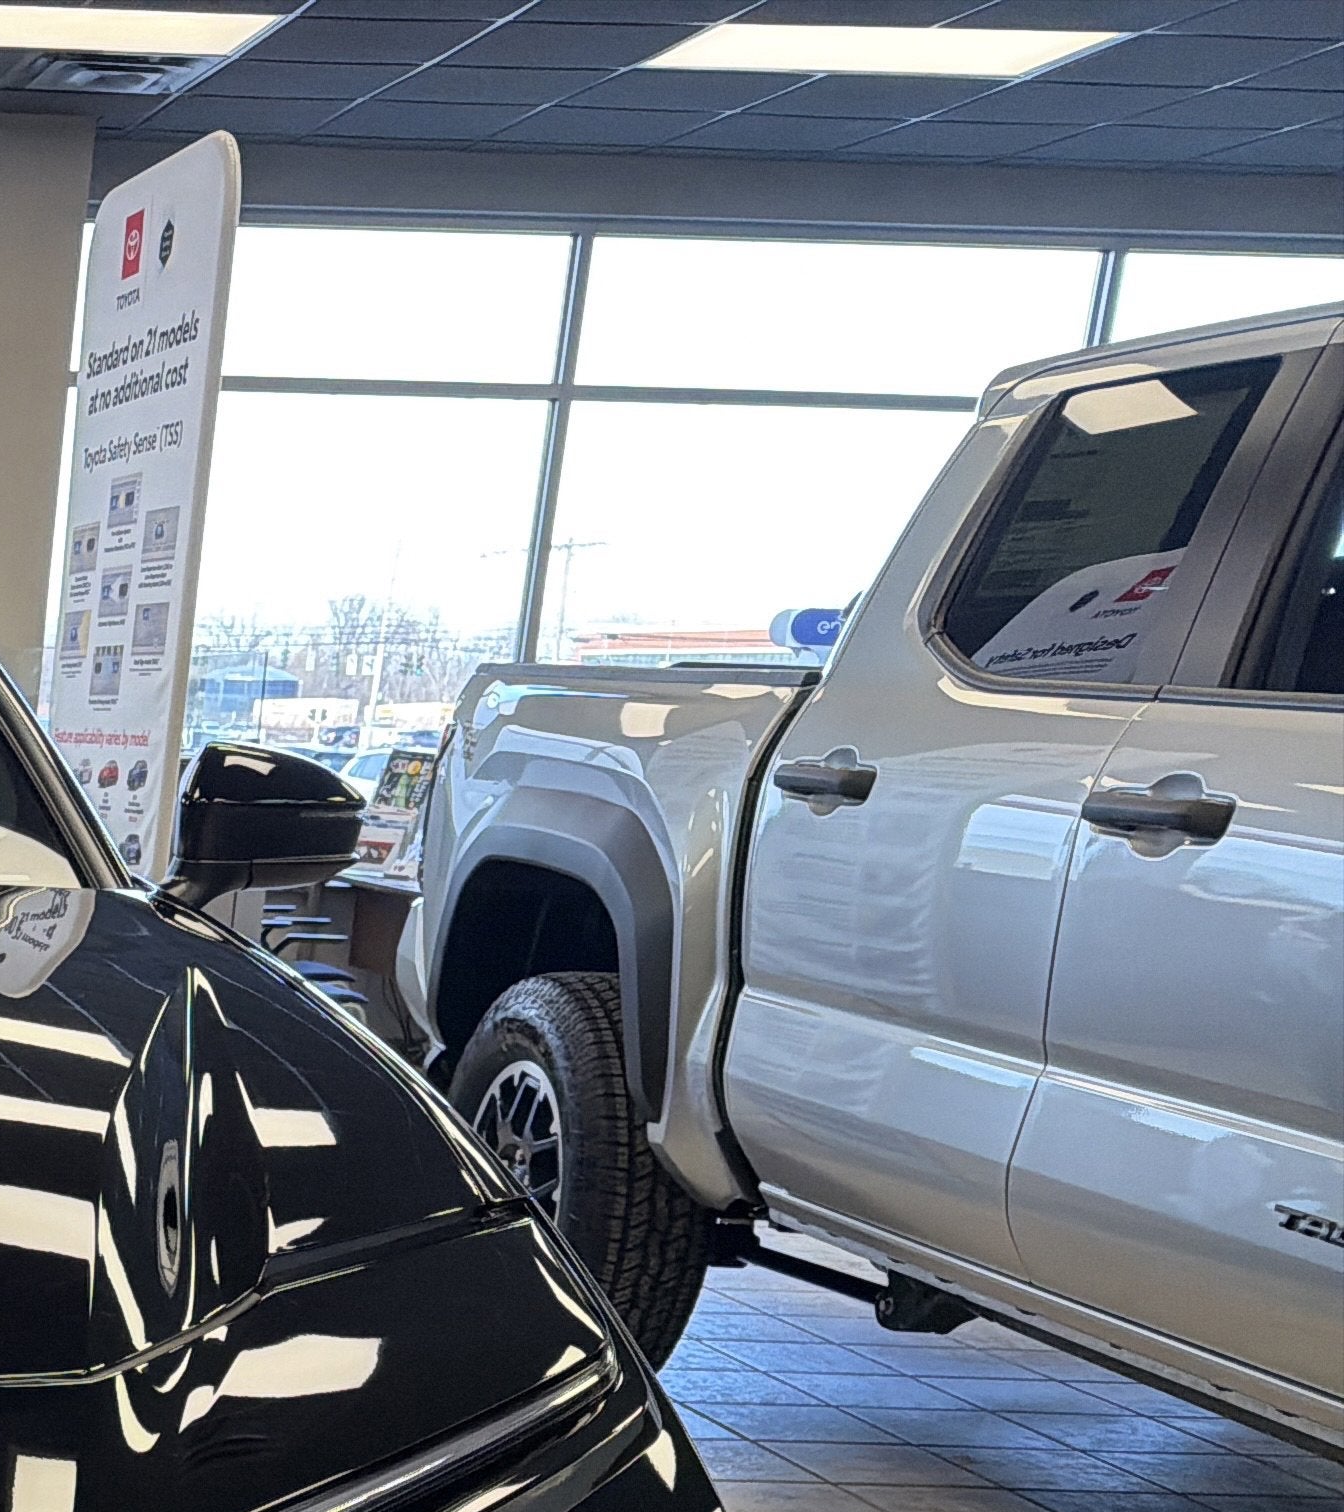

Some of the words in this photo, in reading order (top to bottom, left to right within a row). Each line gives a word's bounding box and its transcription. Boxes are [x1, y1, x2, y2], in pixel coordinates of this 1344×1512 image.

[116, 287, 141, 312] TOYOTA
[86, 334, 132, 380] Standard
[130, 338, 144, 363] on
[144, 324, 159, 358] 21
[157, 309, 200, 353] models
[88, 388, 99, 416] at
[98, 389, 111, 413] no
[112, 360, 166, 408] additional
[164, 356, 189, 391] cost
[83, 444, 107, 474] Toyota
[107, 435, 132, 464] Safety
[159, 419, 184, 453] (TSS)
